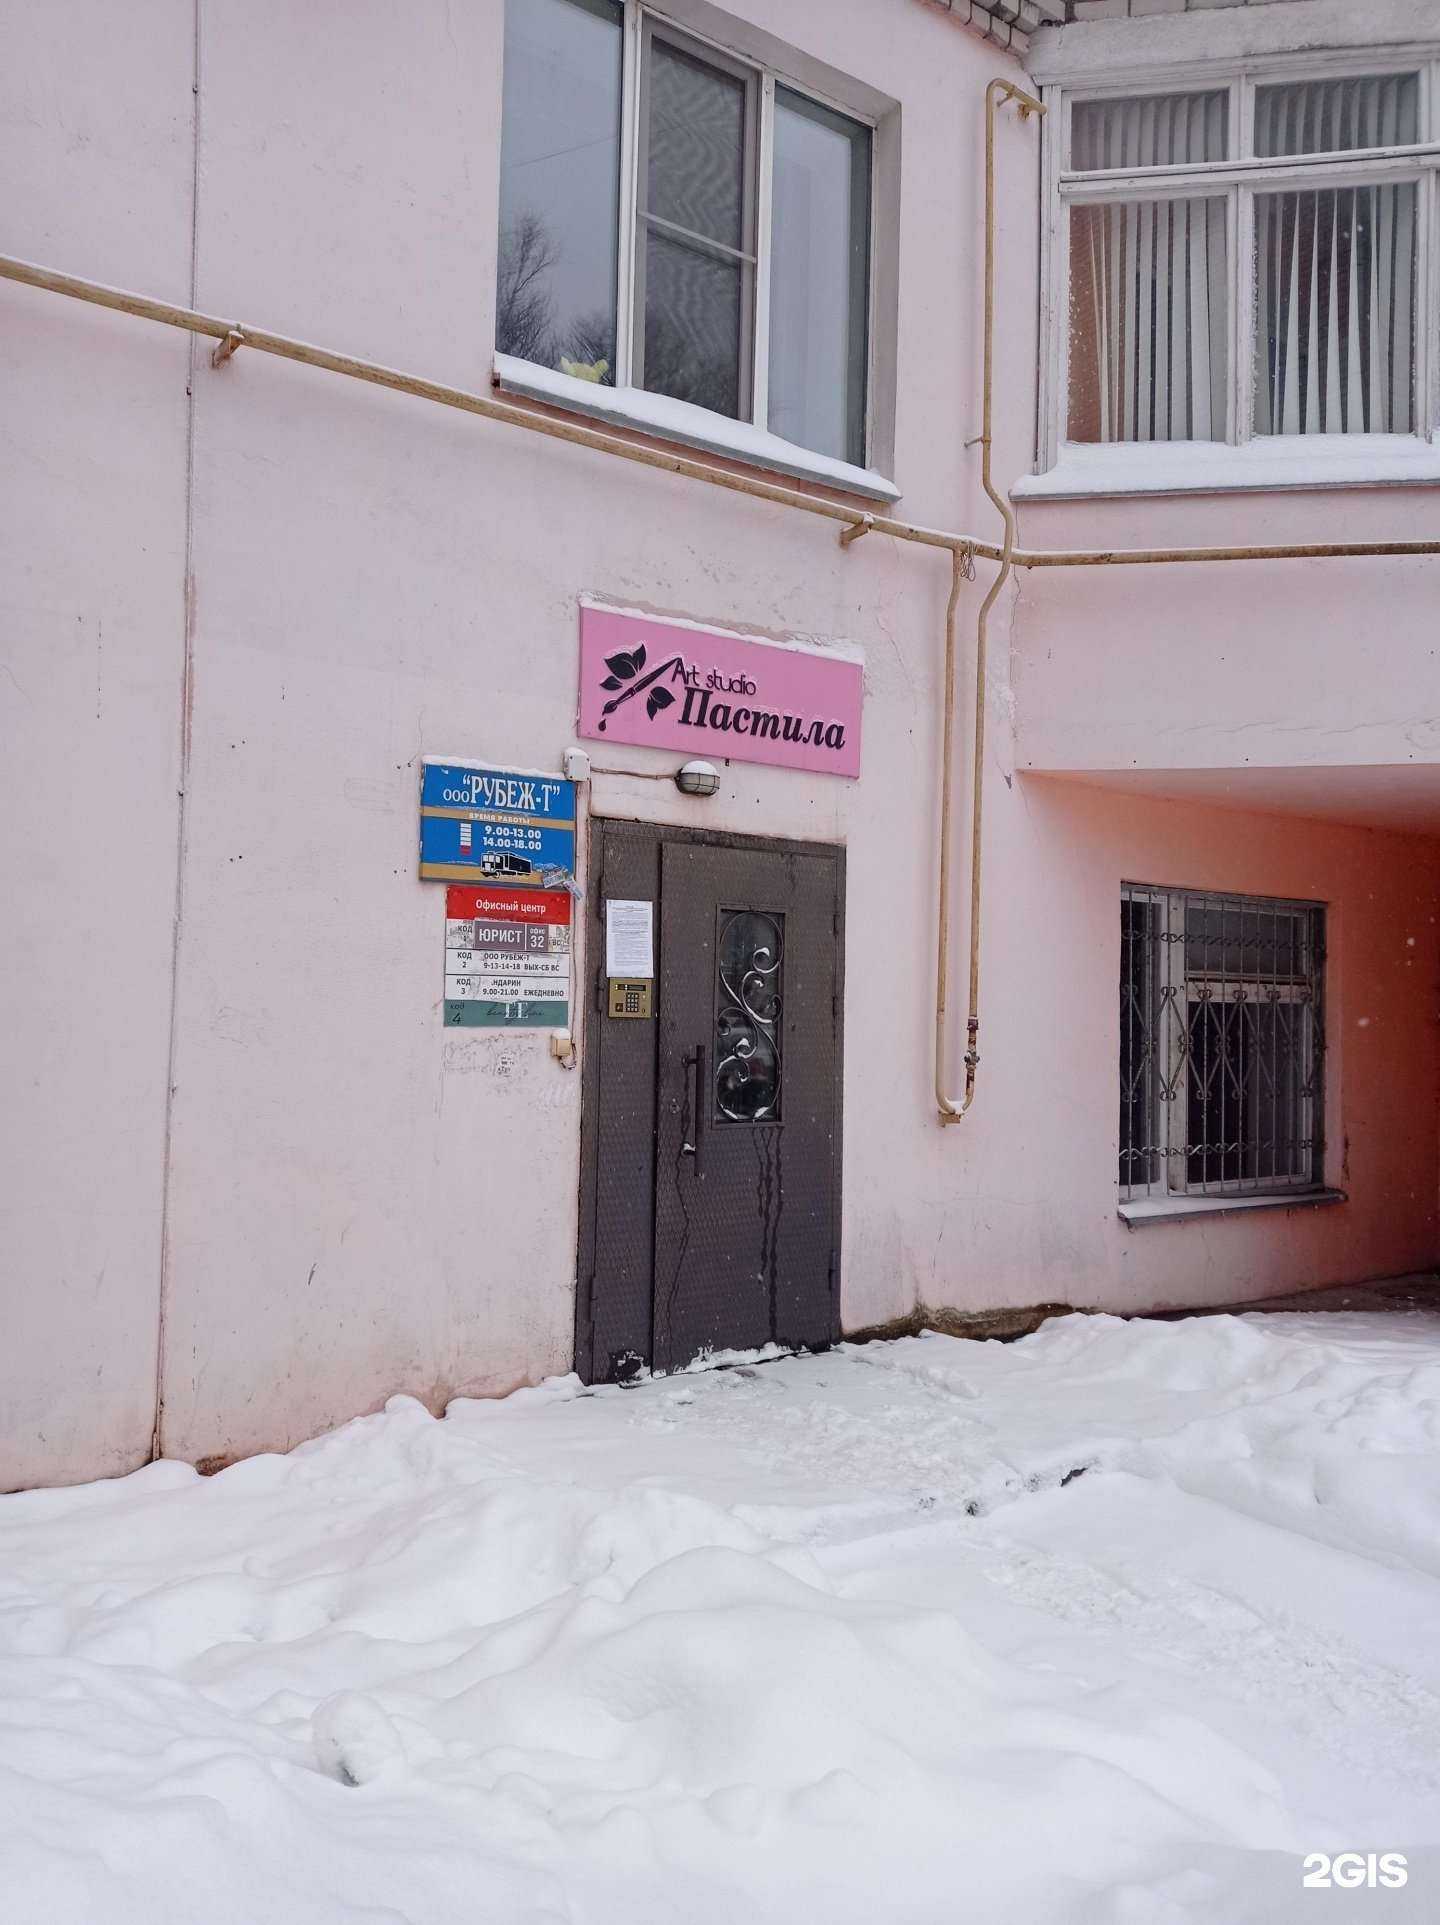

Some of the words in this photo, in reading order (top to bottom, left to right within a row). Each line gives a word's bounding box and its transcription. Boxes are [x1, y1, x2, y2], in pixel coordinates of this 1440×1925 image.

[672, 661, 699, 687] Art
[706, 669, 757, 696] studio
[678, 686, 845, 750] Пастила
[468, 812, 496, 822] ВРЕМЯ
[498, 815, 531, 825] РАБОТЫ
[485, 825, 542, 840] 9.00-13.00
[483, 837, 542, 851] 14.00-18.00
[475, 899, 519, 912] Офисный
[521, 905, 546, 915] центр
[479, 928, 523, 944] ЮРИСТ
[530, 935, 545, 948] 32
[457, 952, 473, 960] КОД
[456, 978, 471, 986] КОД
[482, 988, 519, 996] 9.00-21.00
[523, 989, 564, 997] ЕЖЕДНЕВНО
[452, 1012, 461, 1025] 4
